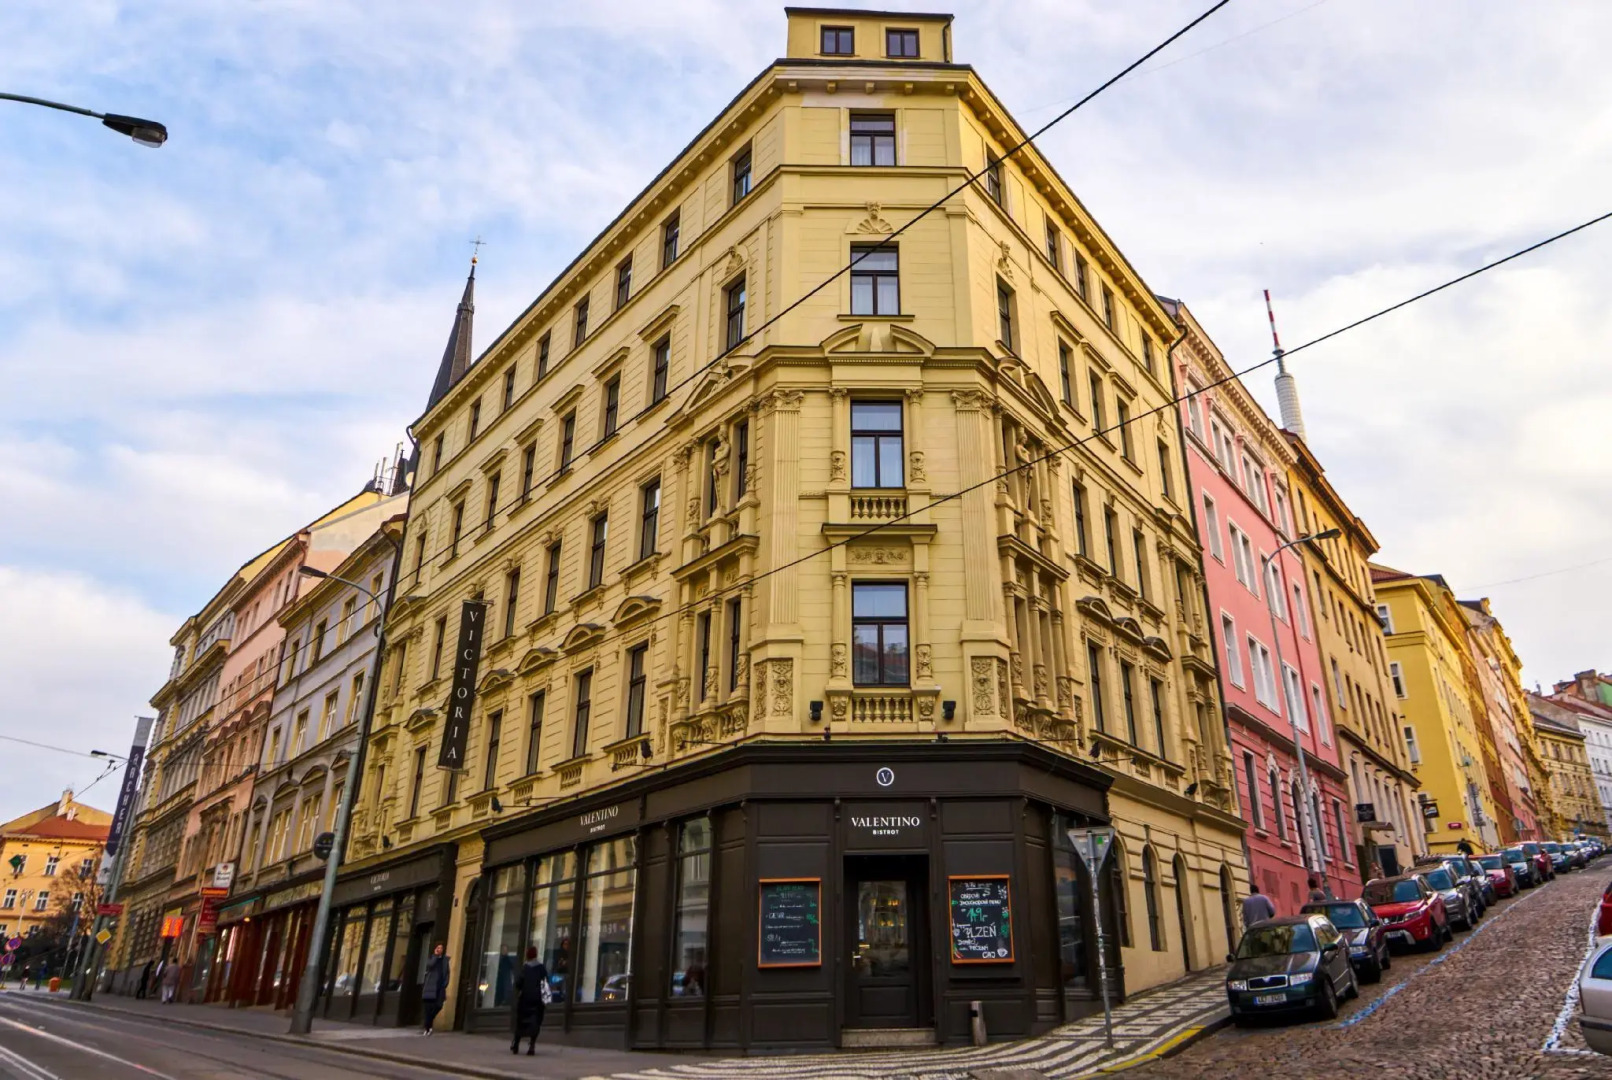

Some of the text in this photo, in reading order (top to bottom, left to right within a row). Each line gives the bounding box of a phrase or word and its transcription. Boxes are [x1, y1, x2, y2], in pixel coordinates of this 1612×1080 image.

[447, 611, 479, 759] VICTORIA
[580, 806, 619, 825] VALENTINO
[851, 816, 920, 827] VALENTINO
